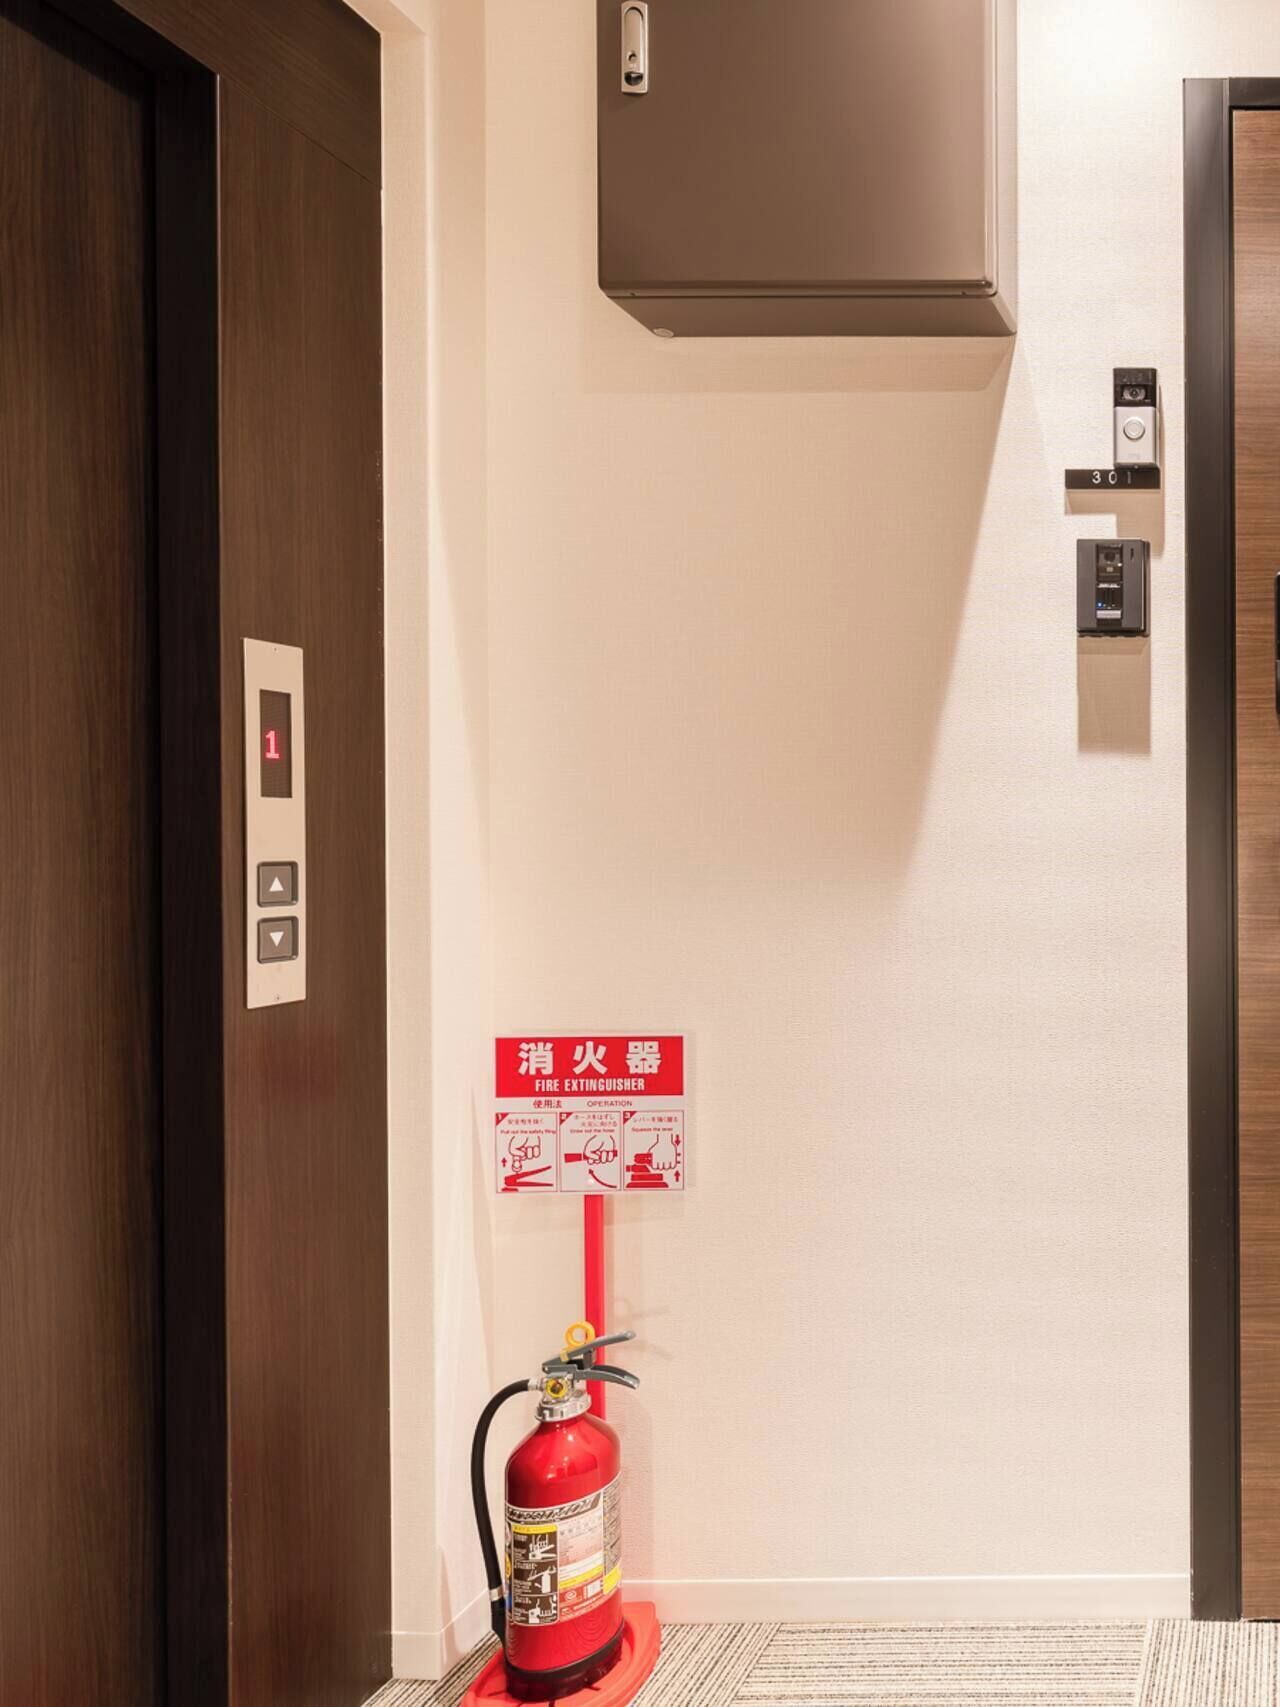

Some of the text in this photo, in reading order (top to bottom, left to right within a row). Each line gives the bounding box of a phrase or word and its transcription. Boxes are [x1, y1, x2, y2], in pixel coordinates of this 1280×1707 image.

[1091, 470, 1132, 485] 301
[265, 730, 280, 759] 1
[517, 1040, 662, 1076] 消火器
[535, 1078, 645, 1092] FIRE EXTINGUISHER
[532, 1099, 633, 1109] 使用法 OPERATION
